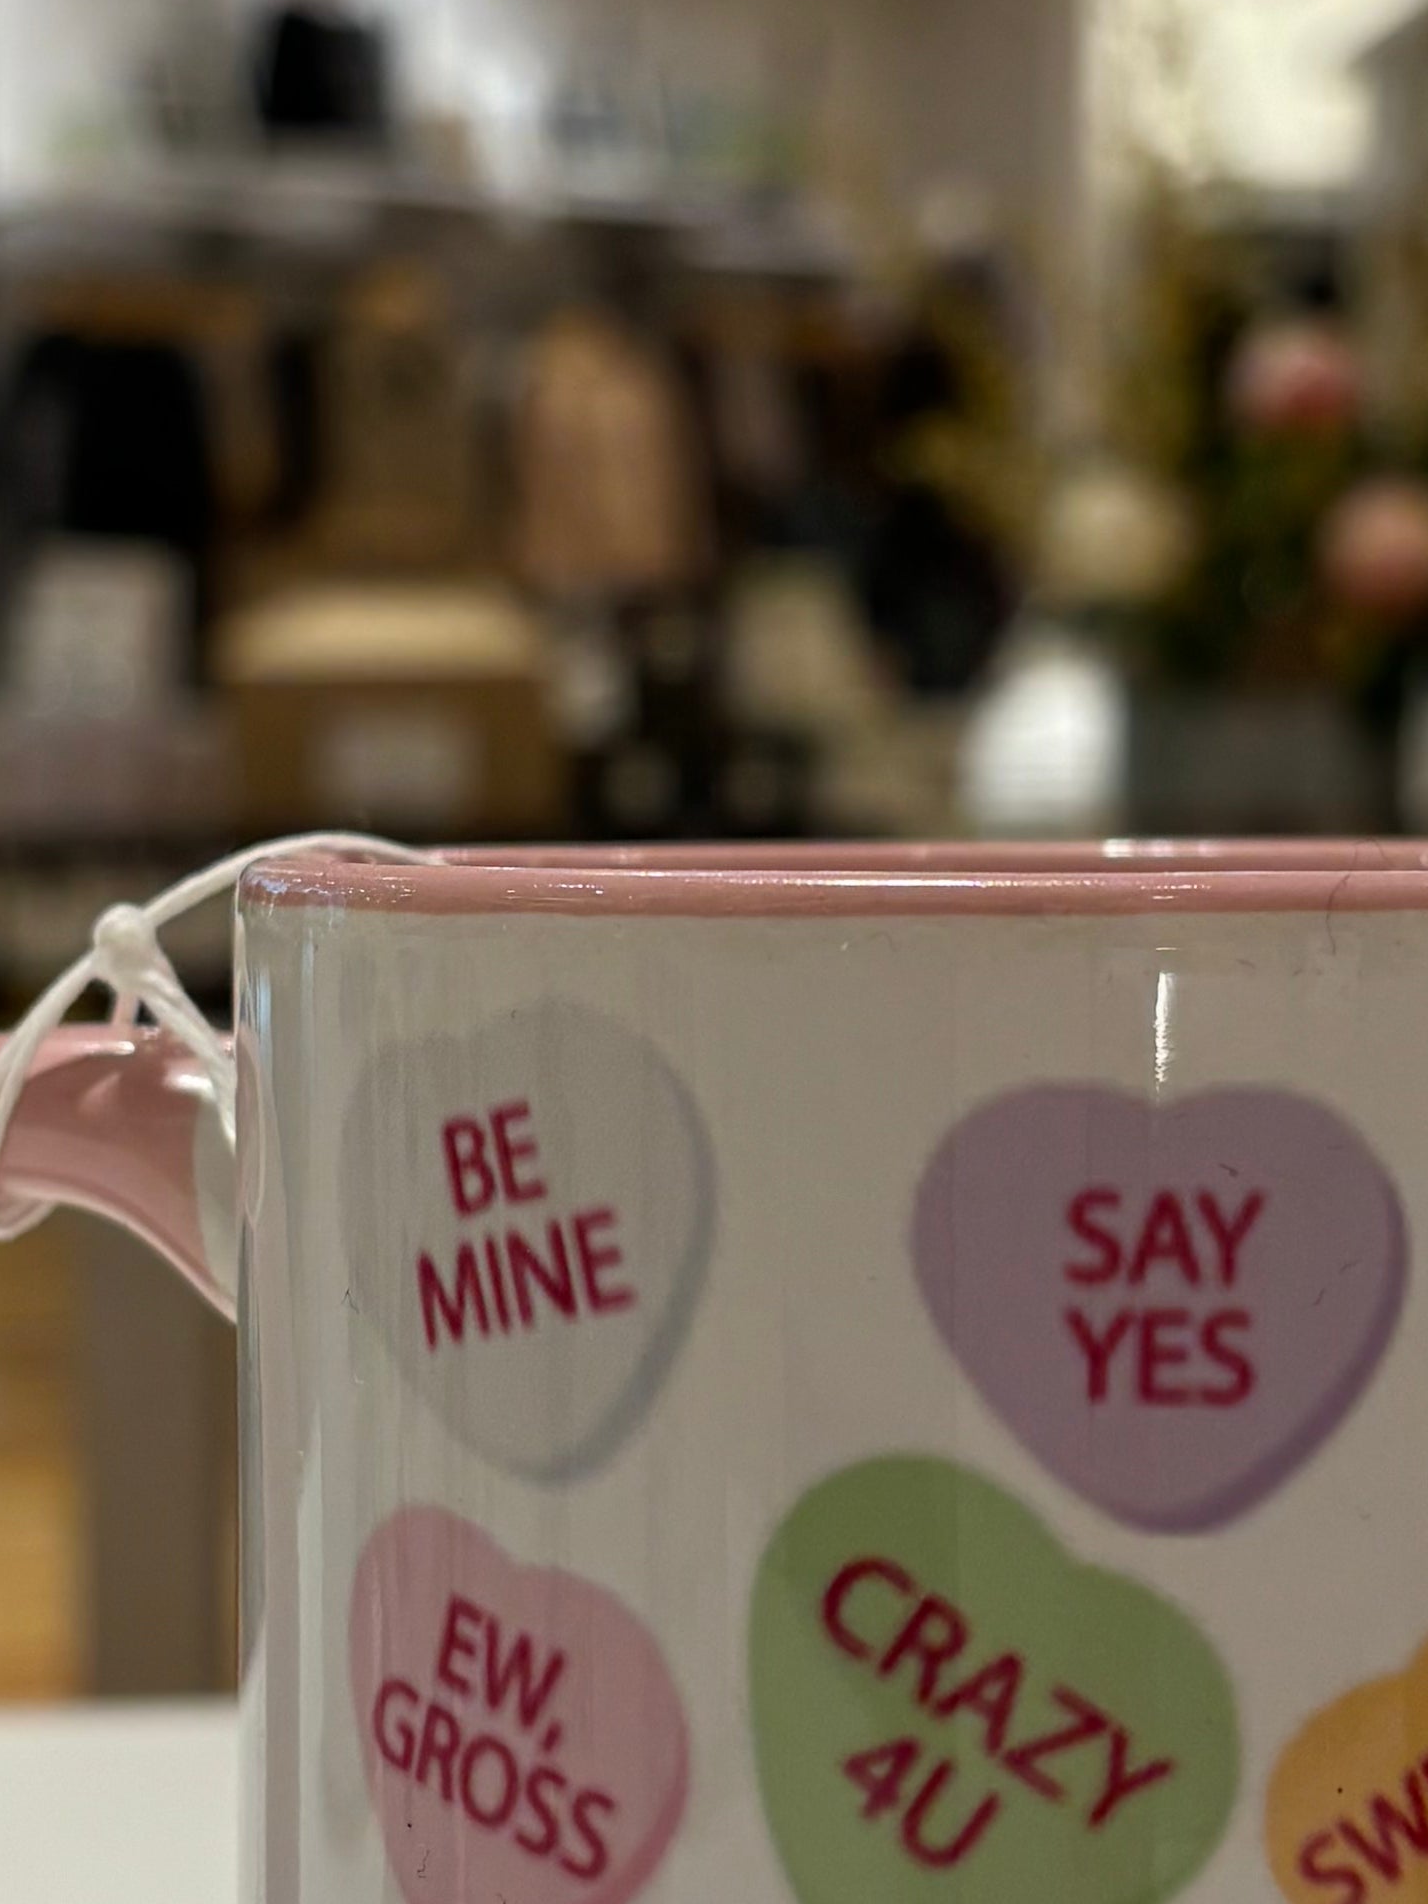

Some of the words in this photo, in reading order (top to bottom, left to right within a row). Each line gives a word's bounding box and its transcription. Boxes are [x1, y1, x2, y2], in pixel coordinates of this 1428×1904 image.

[440, 1098, 550, 1220] BE
[414, 1206, 638, 1354] MINE
[1062, 1185, 1267, 1290] SAY
[1062, 1306, 1258, 1410] YES
[434, 1590, 570, 1756] EW,
[818, 1555, 1177, 1832] CRAZY
[371, 1676, 618, 1886] GROSS
[841, 1735, 1002, 1873] 4U
